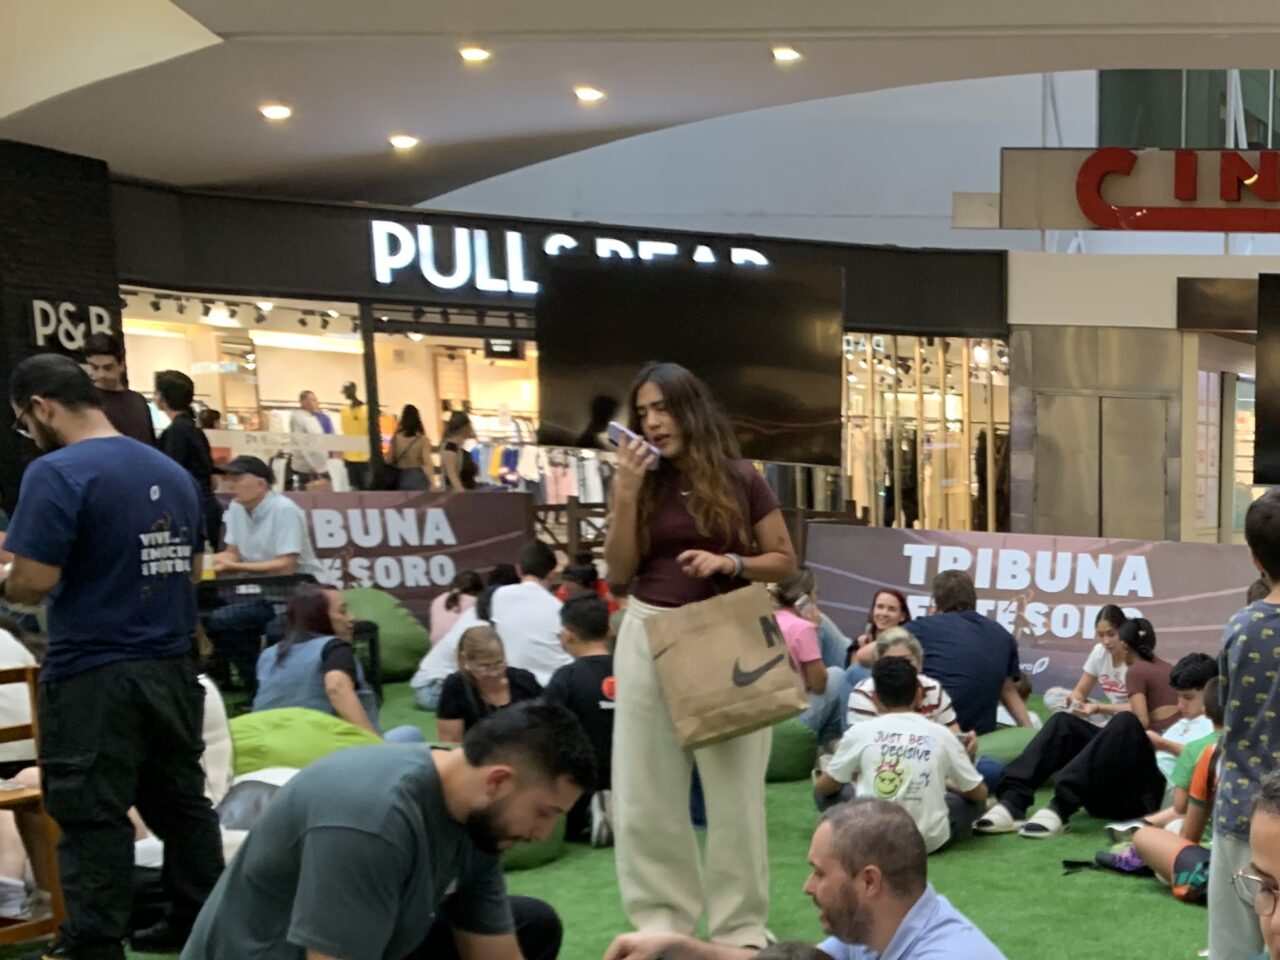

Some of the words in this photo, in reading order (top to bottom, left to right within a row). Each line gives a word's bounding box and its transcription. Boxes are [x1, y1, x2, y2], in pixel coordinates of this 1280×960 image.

[370, 219, 539, 294] PULL
[304, 507, 457, 549] BUNA
[903, 543, 1154, 598] TRIBUNA
[874, 730, 902, 744] JUST
[880, 744, 932, 762] DECISIVE
